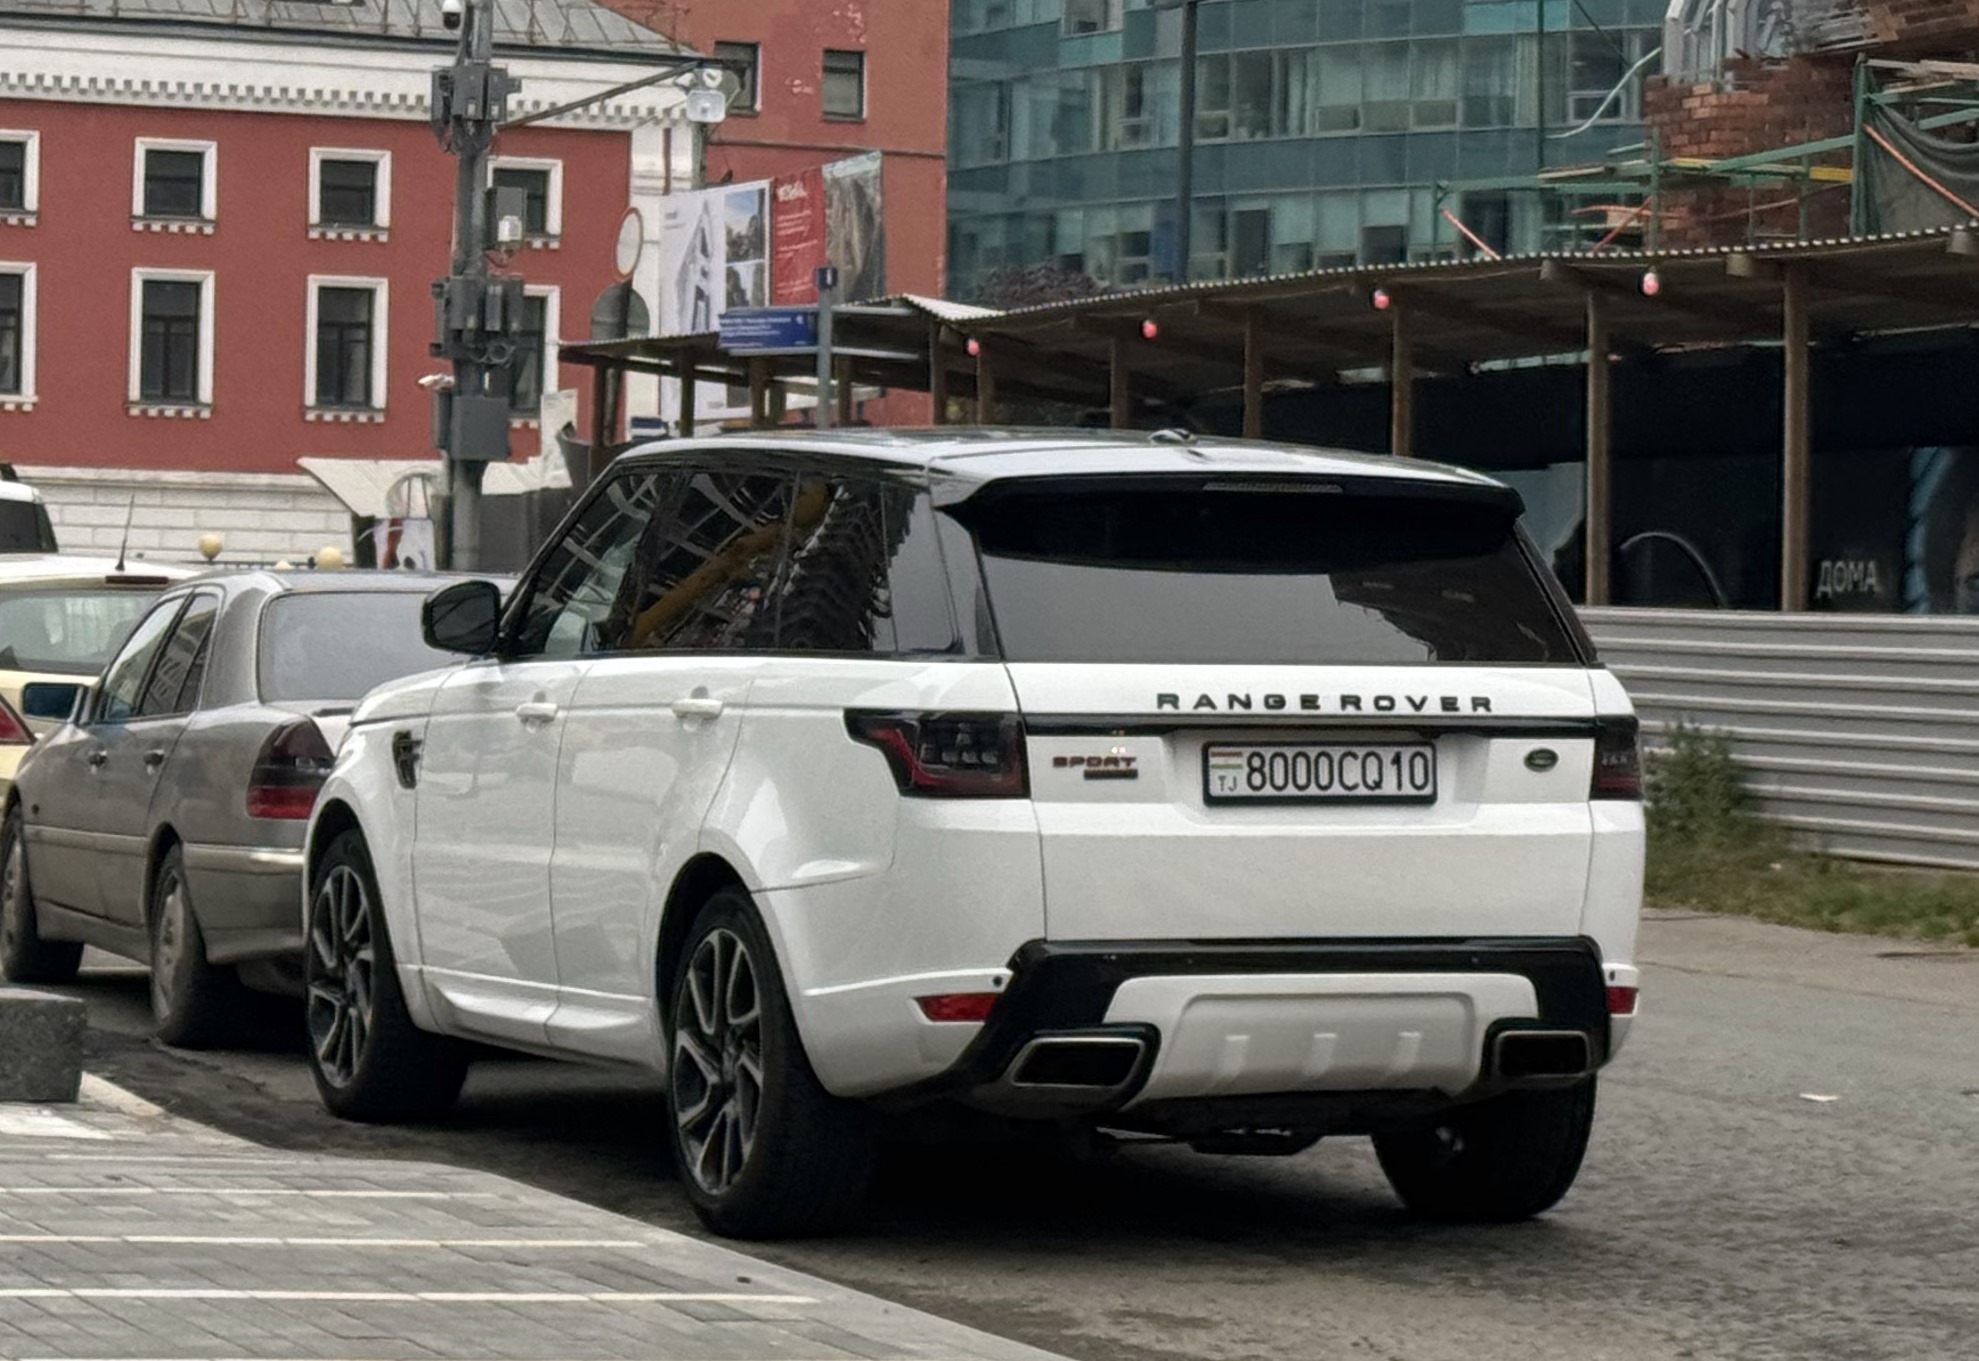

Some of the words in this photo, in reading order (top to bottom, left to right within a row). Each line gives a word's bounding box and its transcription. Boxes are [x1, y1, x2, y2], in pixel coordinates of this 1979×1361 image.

[1815, 560, 1882, 598] ДОМА
[1156, 693, 1321, 711] RANGE
[1340, 694, 1493, 712] ROVER
[1051, 756, 1137, 768] SPORT
[1216, 775, 1238, 792] TJ
[1246, 751, 1430, 791] 8000CQ10
